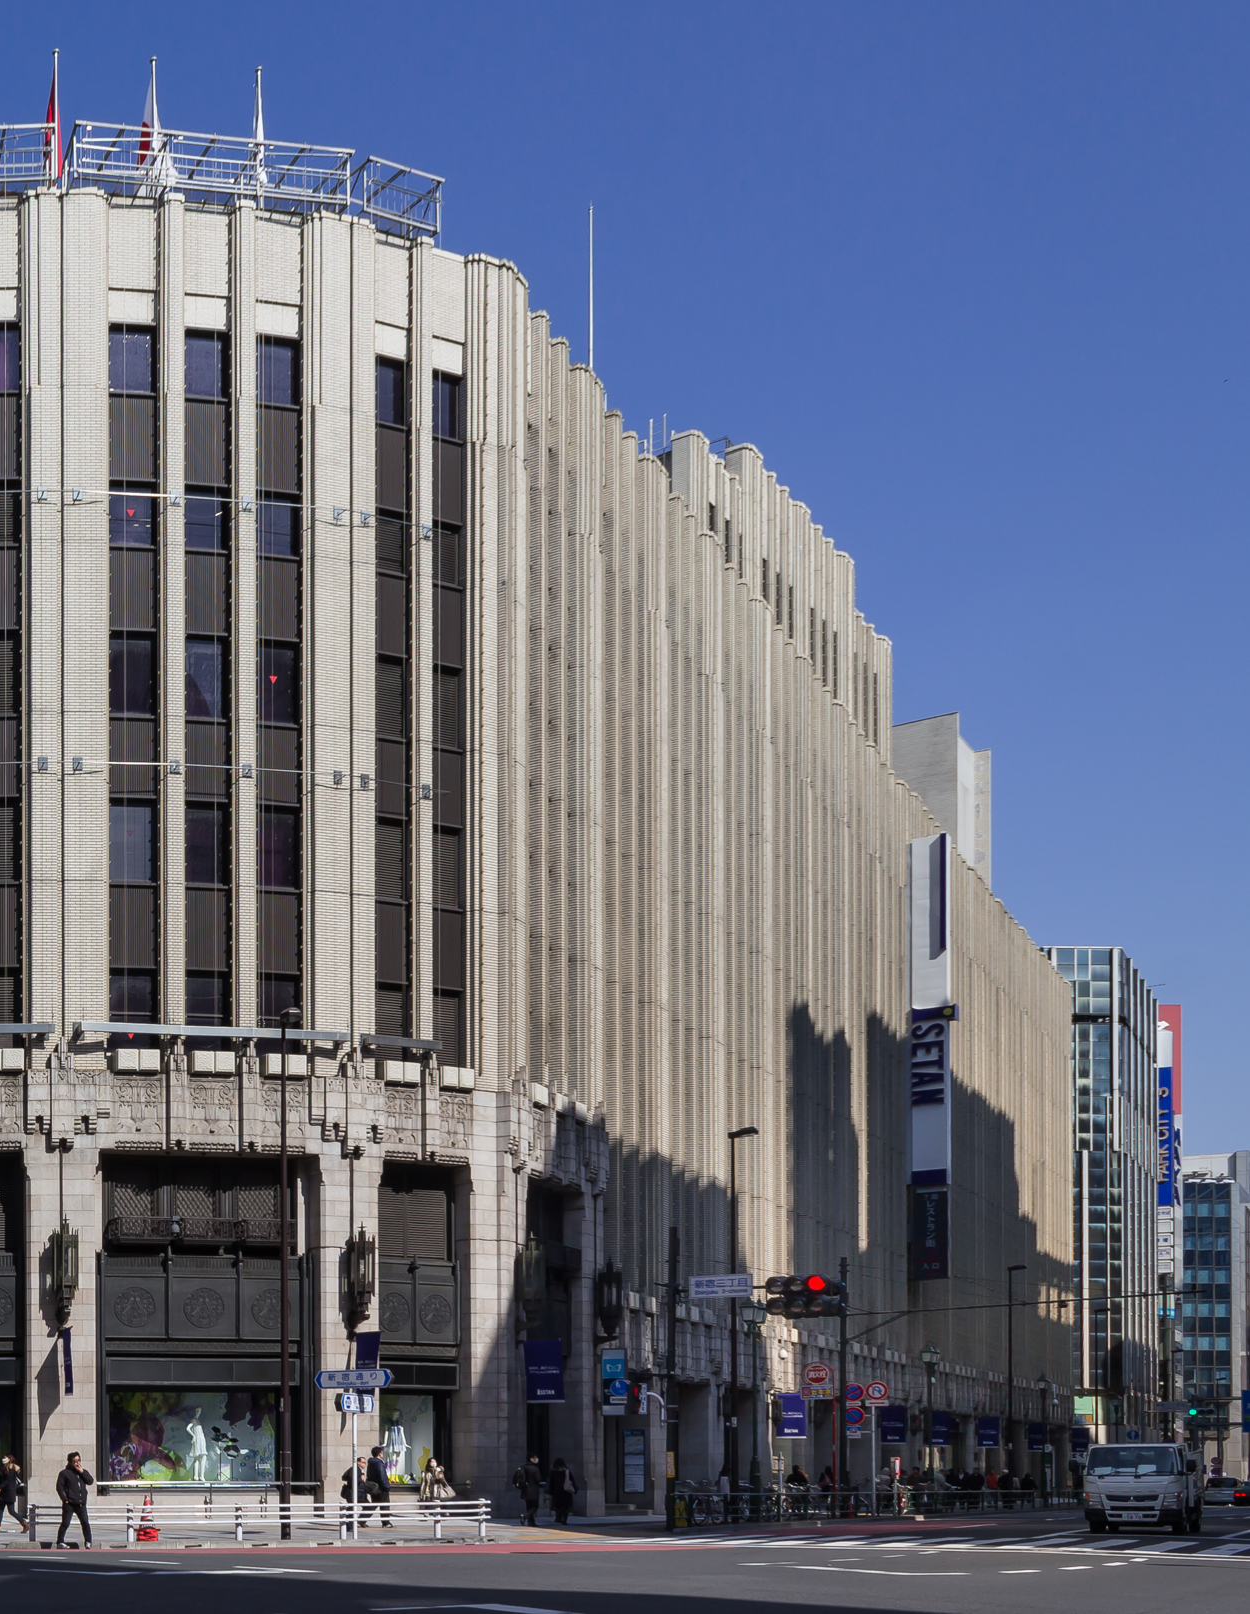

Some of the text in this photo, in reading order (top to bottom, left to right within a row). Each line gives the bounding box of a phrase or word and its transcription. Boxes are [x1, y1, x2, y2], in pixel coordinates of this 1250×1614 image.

[694, 1278, 748, 1289] 新宿三丁目
[328, 1372, 378, 1382] 新宿通り
